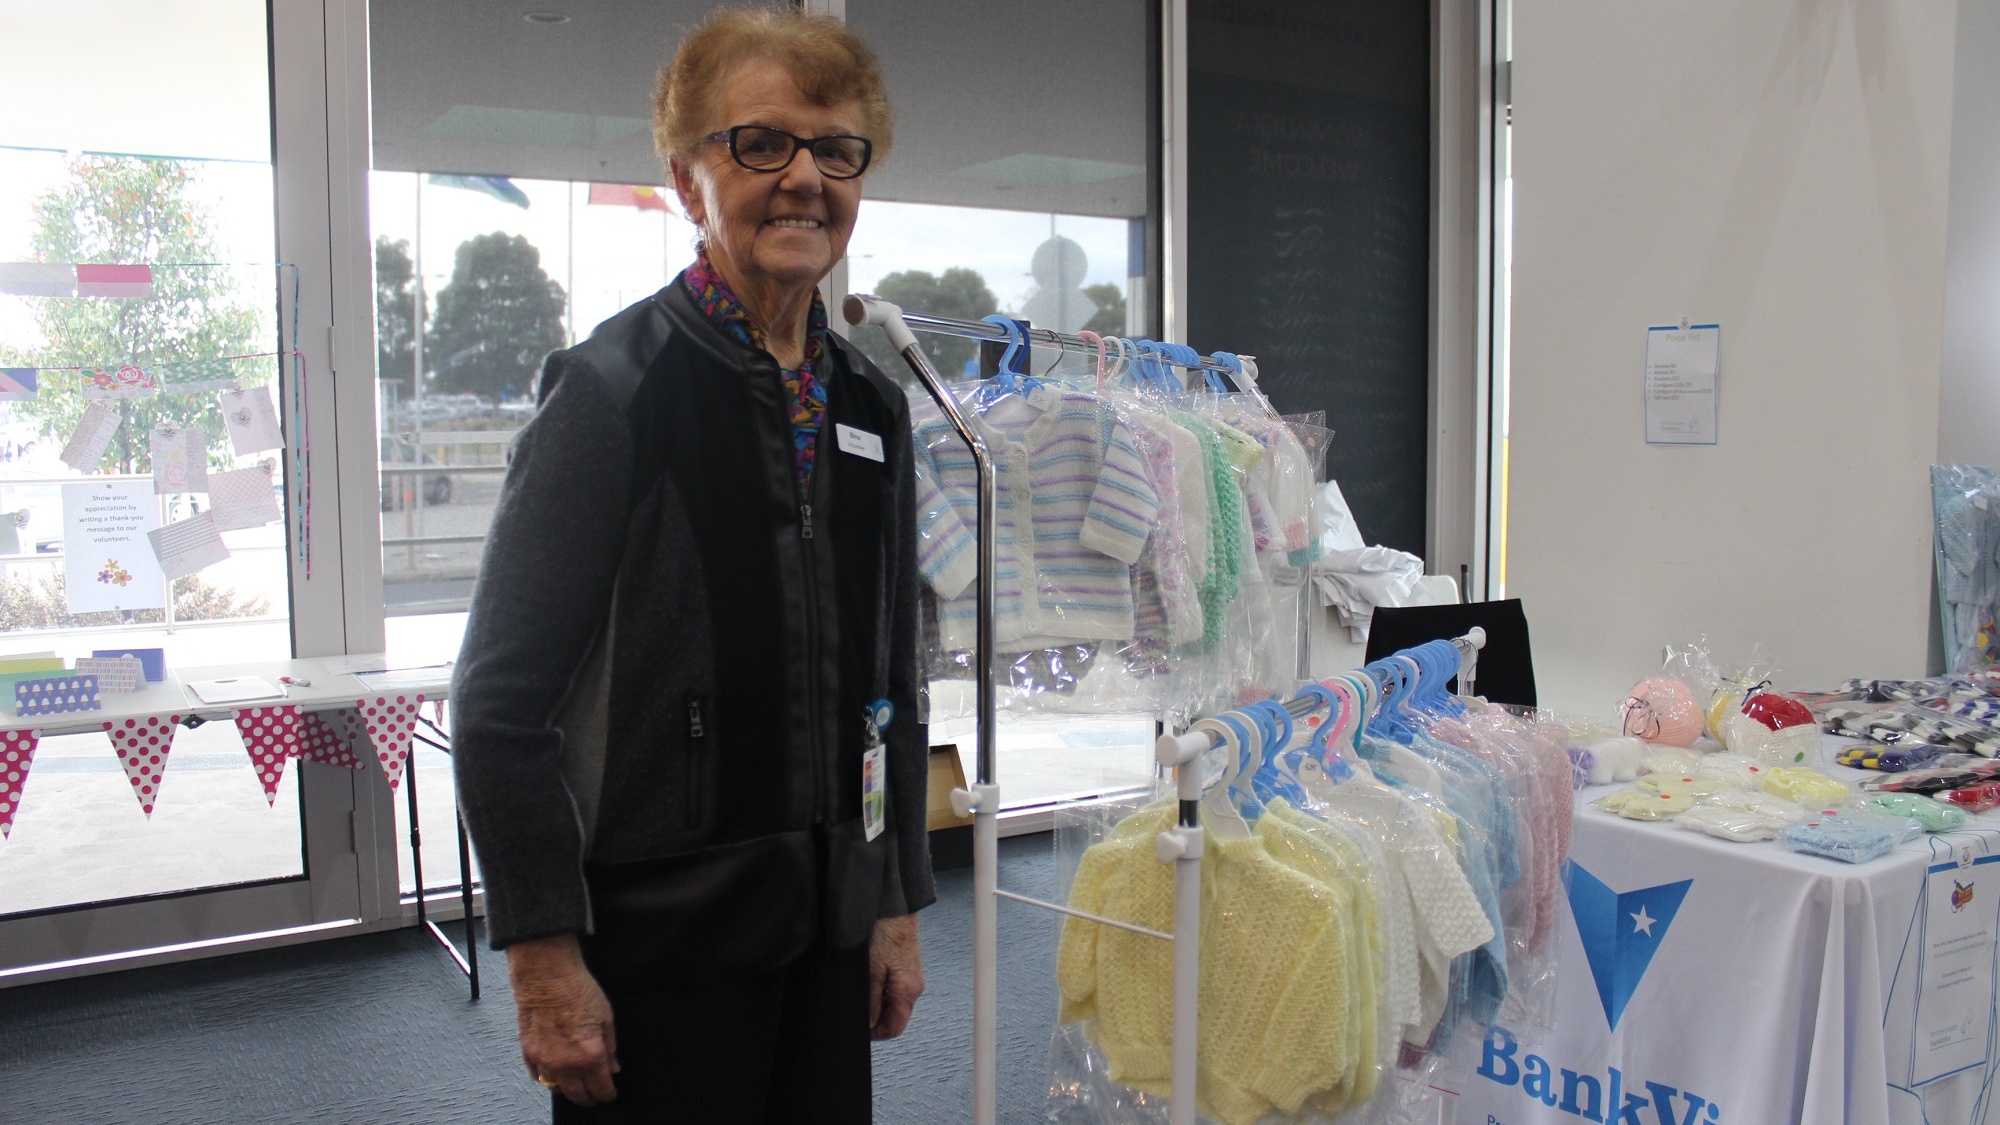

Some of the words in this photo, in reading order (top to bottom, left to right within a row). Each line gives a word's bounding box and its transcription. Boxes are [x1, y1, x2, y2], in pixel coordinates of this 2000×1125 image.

[1665, 333, 1686, 343] Price
[1688, 332, 1701, 342] list
[84, 505, 127, 513] appreciation
[128, 504, 137, 512] by
